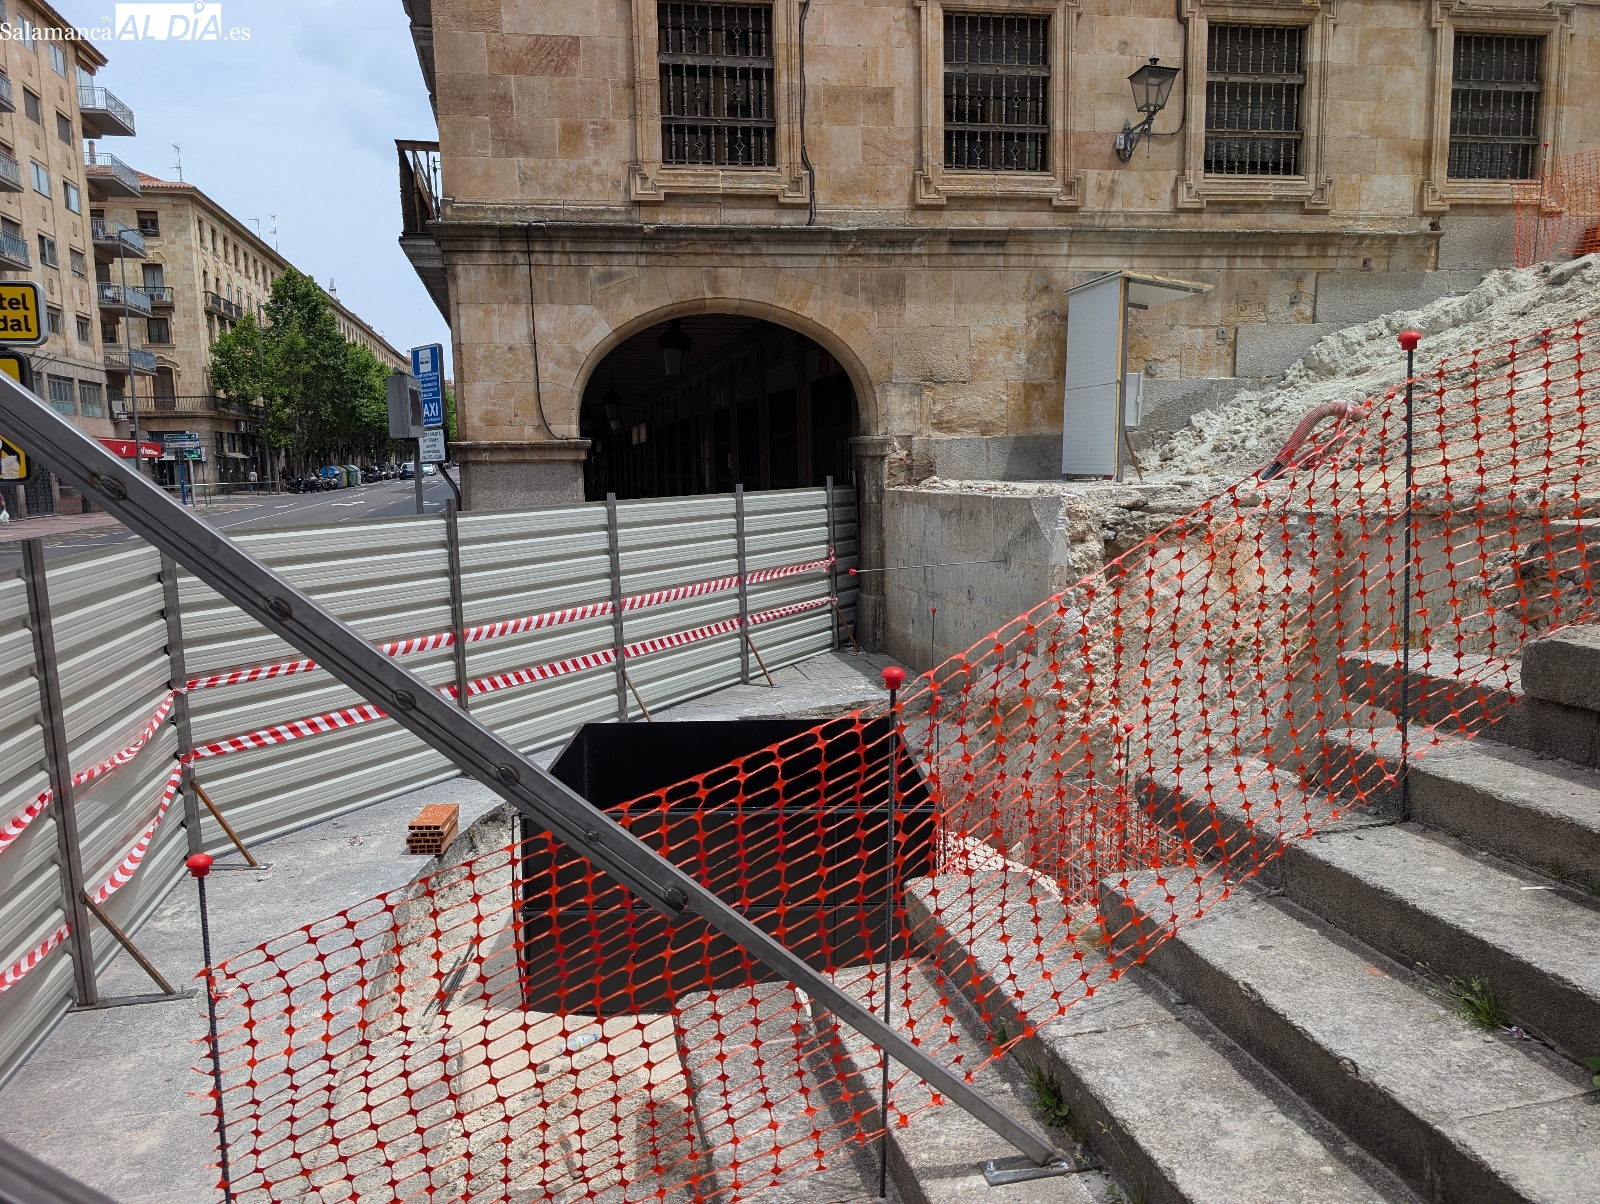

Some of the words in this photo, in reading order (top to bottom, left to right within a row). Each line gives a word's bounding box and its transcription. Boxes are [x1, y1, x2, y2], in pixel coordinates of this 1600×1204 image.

[0, 293, 30, 310] tel
[0, 315, 32, 332] dal
[423, 402, 439, 417] AXI
